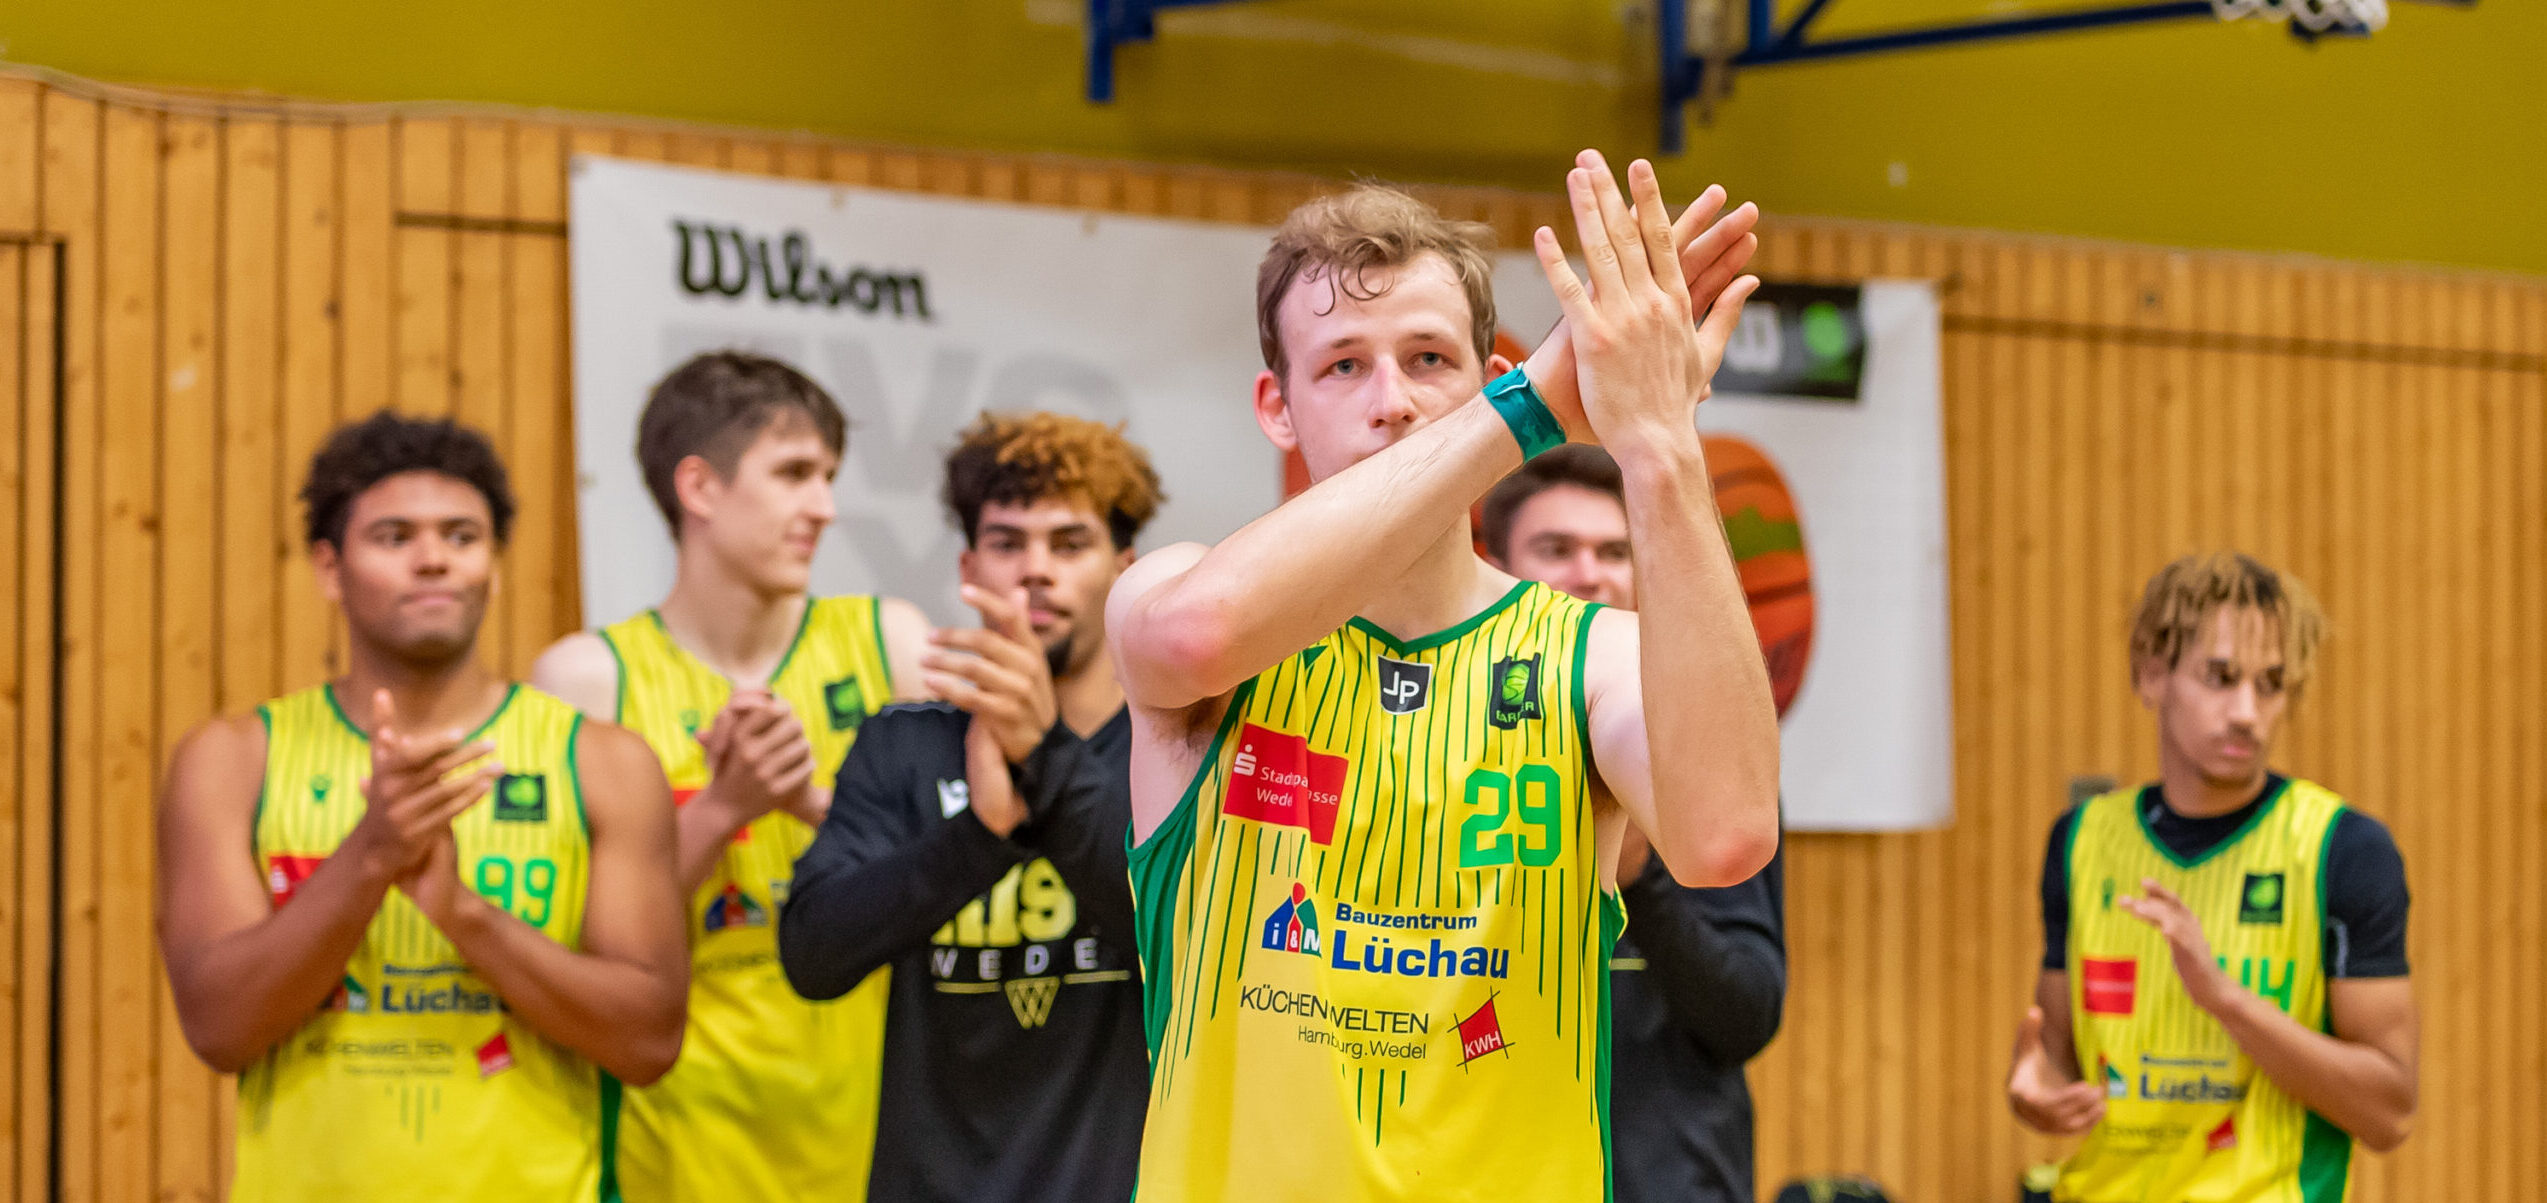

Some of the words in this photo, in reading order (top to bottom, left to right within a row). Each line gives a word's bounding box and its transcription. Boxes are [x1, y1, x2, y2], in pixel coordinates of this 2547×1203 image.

[674, 219, 934, 318] Wilson
[1383, 671, 1420, 704] JP
[1459, 763, 1562, 868] 29
[476, 856, 557, 928] 99
[1335, 902, 1478, 930] Bauzentrum
[1331, 929, 1510, 979] Lüchau
[1239, 984, 1430, 1034] KÜCHENWELTEN
[1464, 1032, 1503, 1060] KWH
